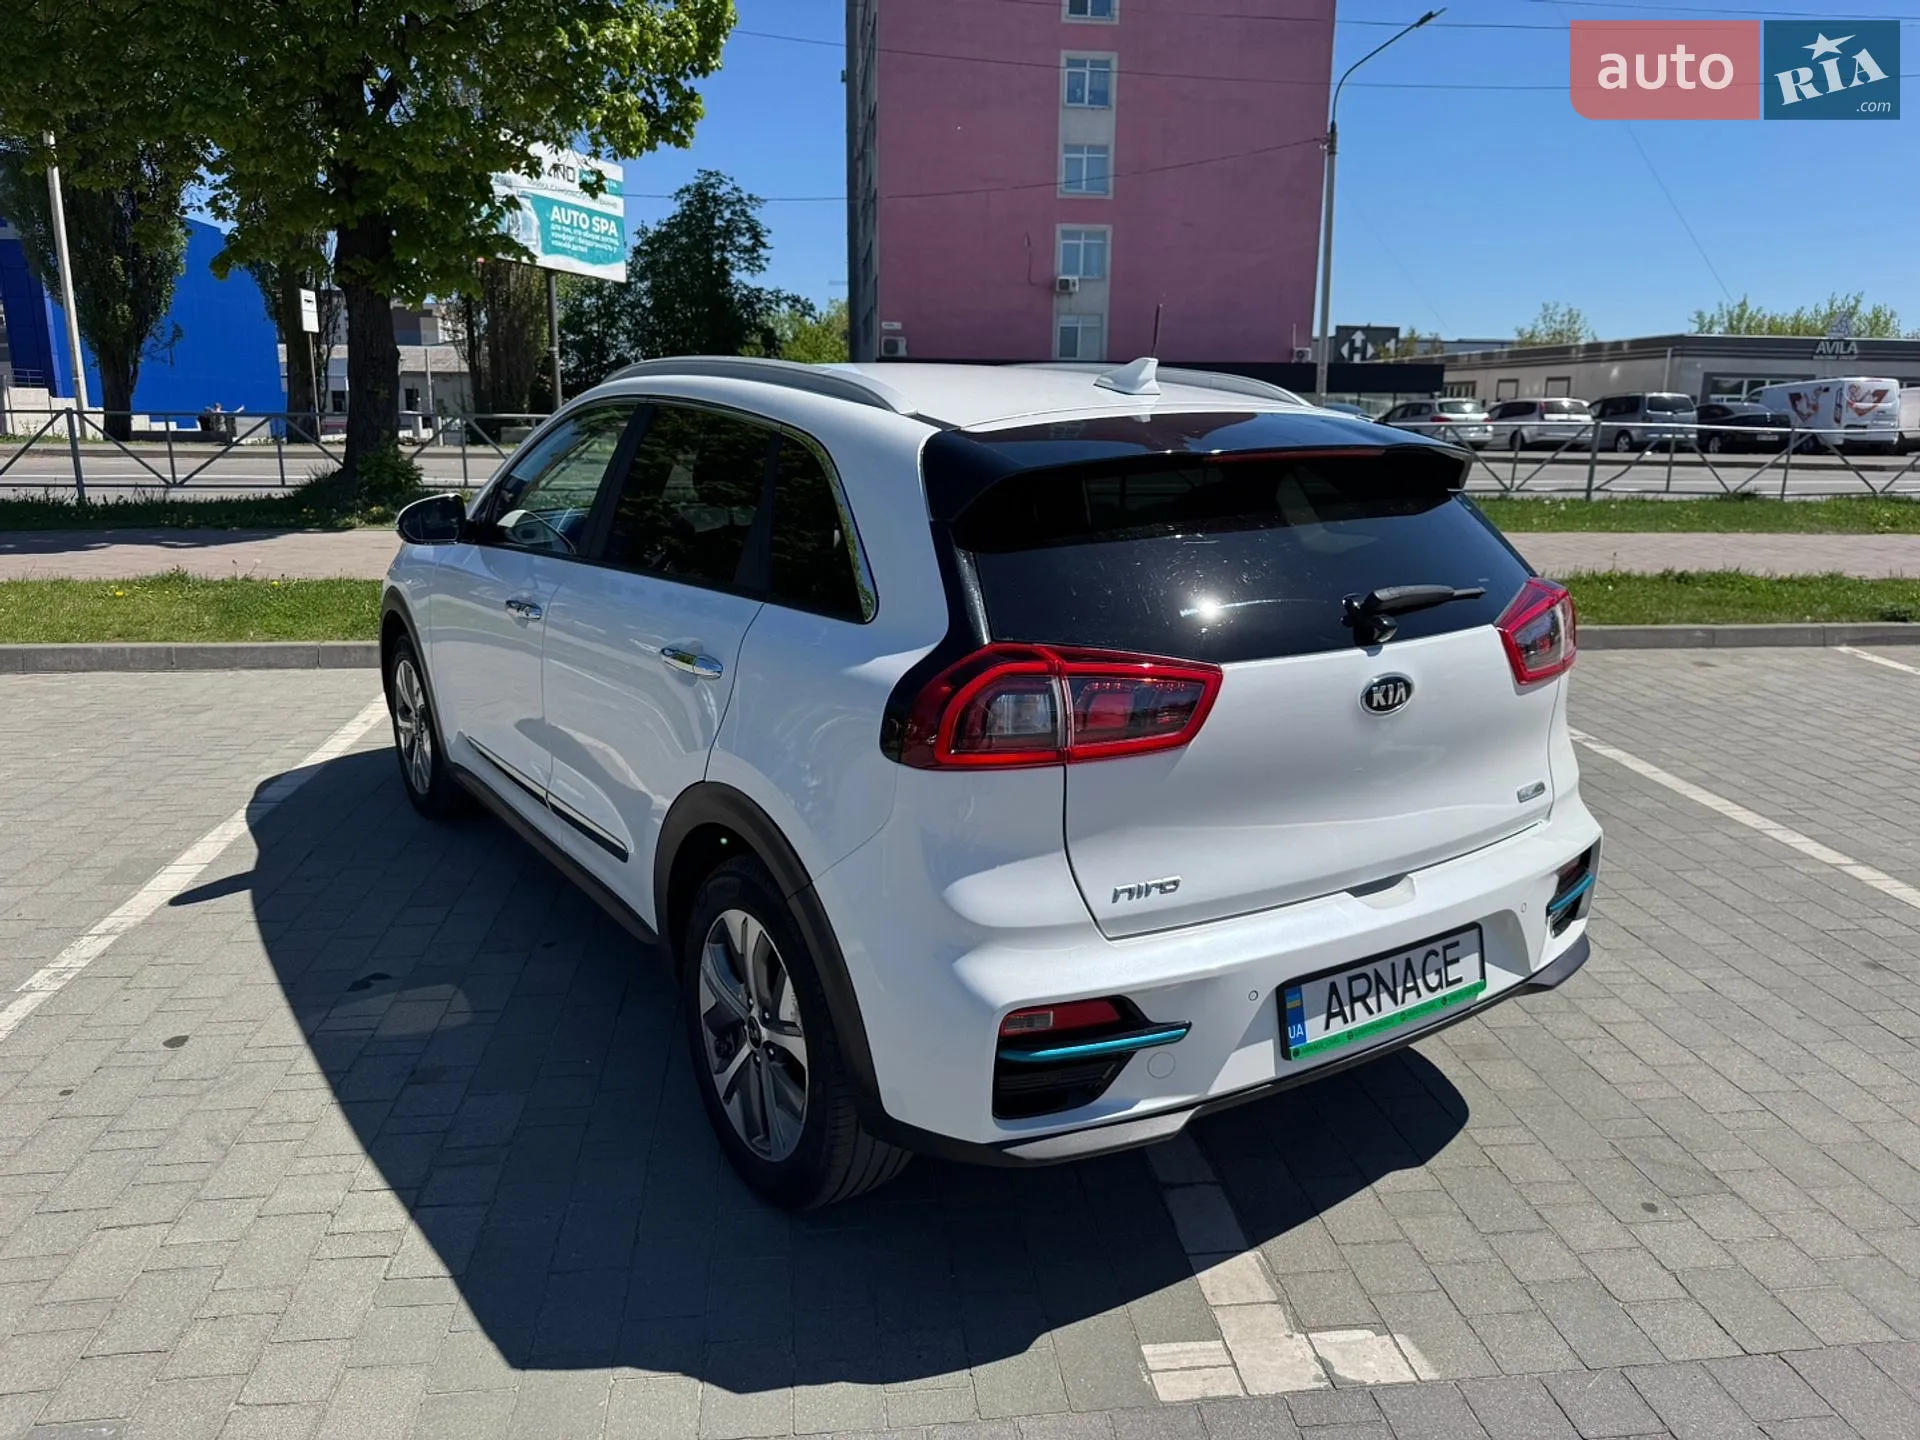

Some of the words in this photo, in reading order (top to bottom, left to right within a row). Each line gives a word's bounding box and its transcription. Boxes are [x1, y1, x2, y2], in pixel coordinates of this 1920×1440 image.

[550, 205, 590, 230] AUTO
[591, 215, 618, 237] SPA
[1815, 340, 1859, 355] AVILA
[1372, 682, 1407, 708] KIA
[1323, 940, 1464, 1032] ARNAGE
[1288, 1024, 1305, 1040] UA
